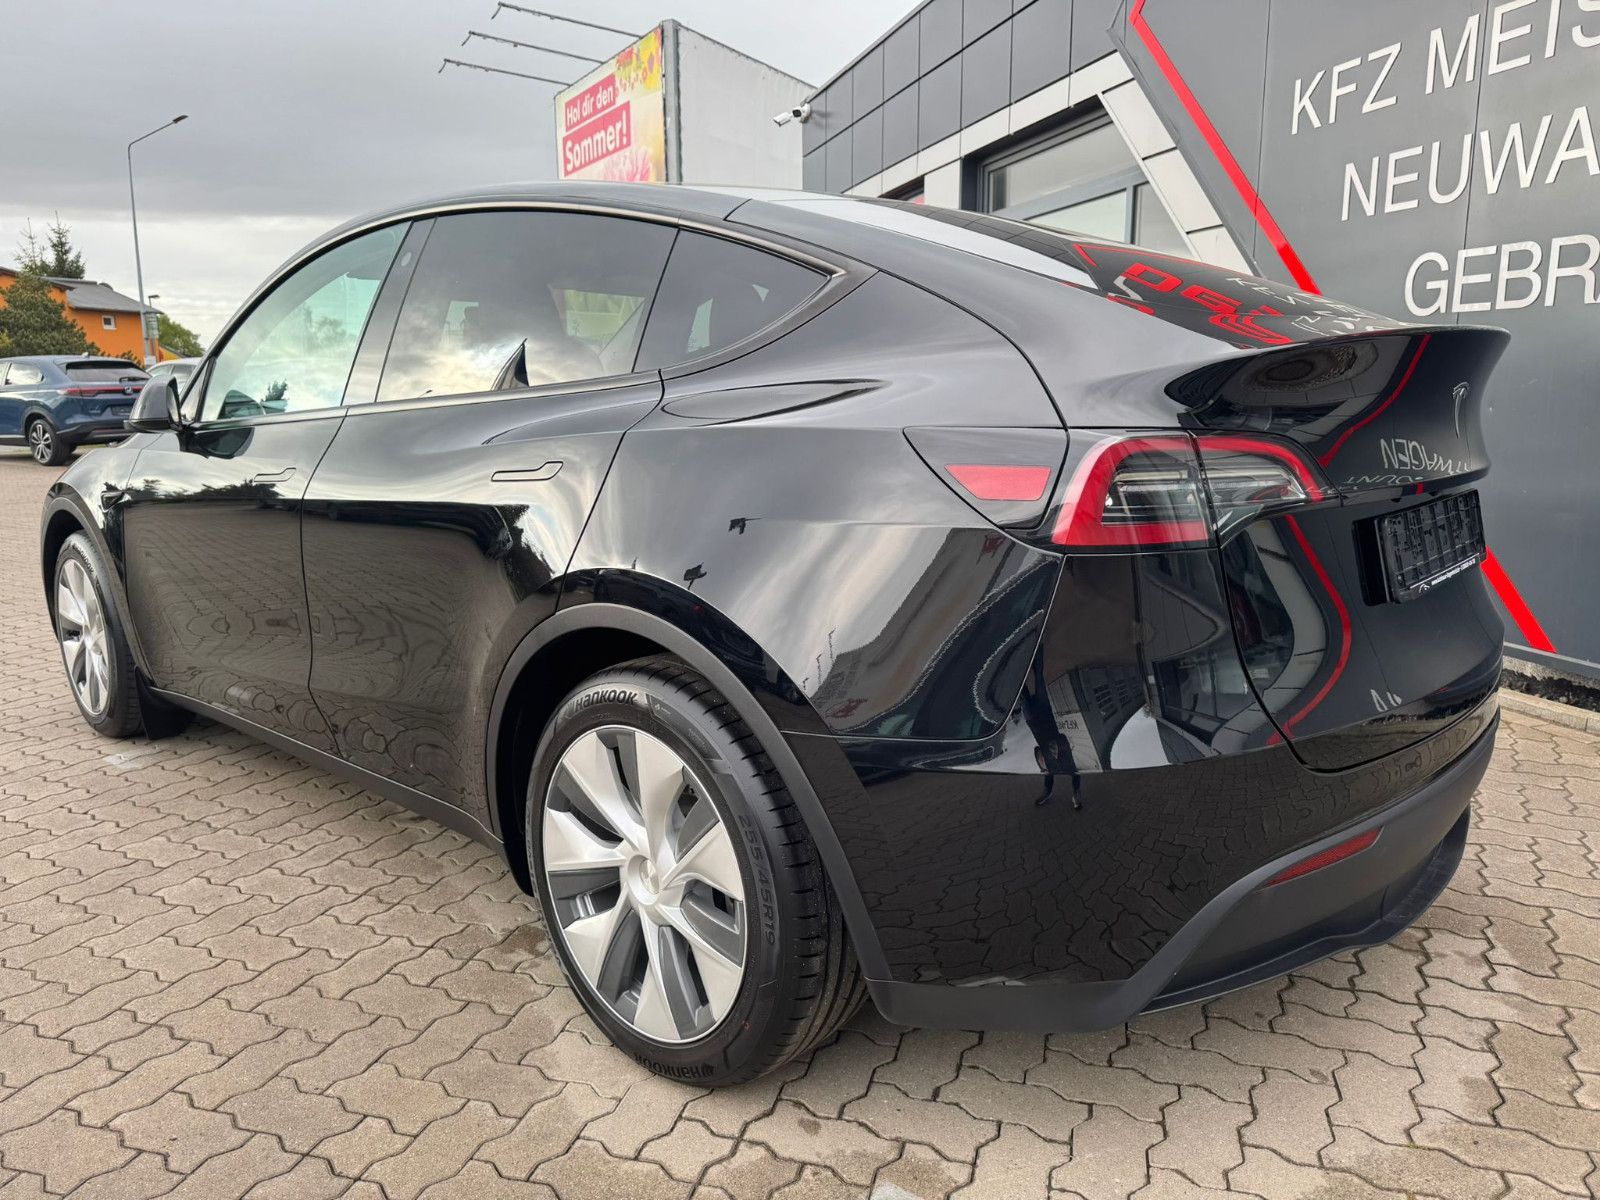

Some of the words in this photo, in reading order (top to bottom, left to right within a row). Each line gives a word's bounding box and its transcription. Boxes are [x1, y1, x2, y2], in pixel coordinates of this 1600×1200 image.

[566, 98, 581, 127] Hol
[581, 93, 594, 117] dir
[596, 85, 614, 109] den
[1291, 42, 1402, 135] KFZ
[1425, 0, 1600, 95] MEIS
[565, 110, 627, 172] Sommer!
[1341, 106, 1600, 221] NEUWA
[1404, 234, 1600, 317] GEBR
[738, 814, 776, 946] 255/45R19
